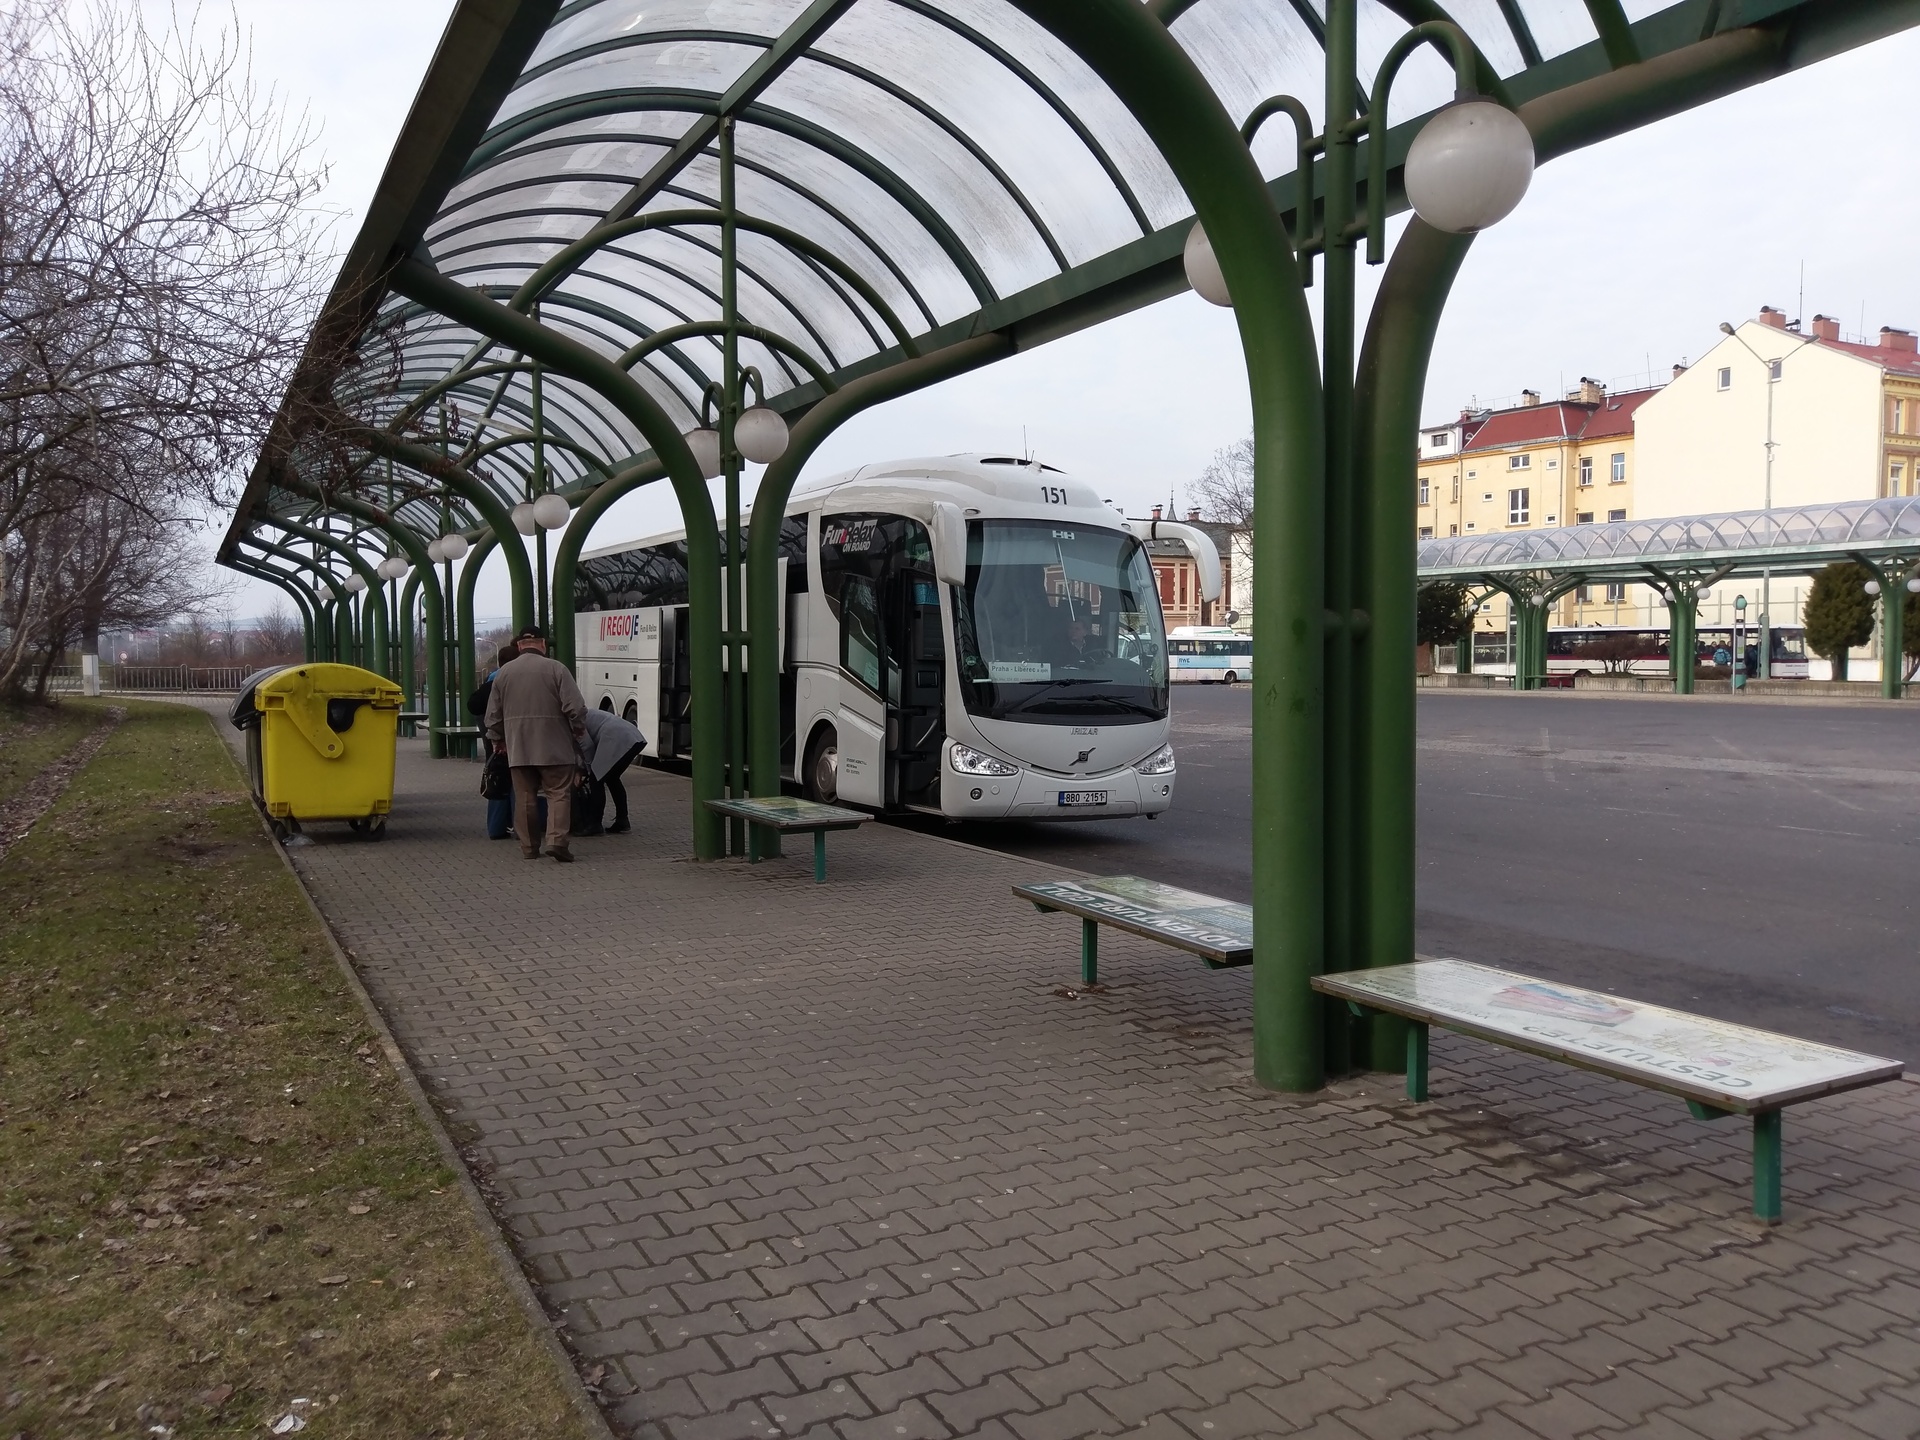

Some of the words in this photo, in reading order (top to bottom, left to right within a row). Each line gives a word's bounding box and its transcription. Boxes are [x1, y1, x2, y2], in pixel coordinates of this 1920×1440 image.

[1041, 486, 1067, 505] 151
[1085, 792, 1103, 802] 2151
[1029, 885, 1091, 902] GOLF
[1088, 901, 1251, 947] ADVENTURE
[1522, 1025, 1753, 1088] CESTUJETE?
